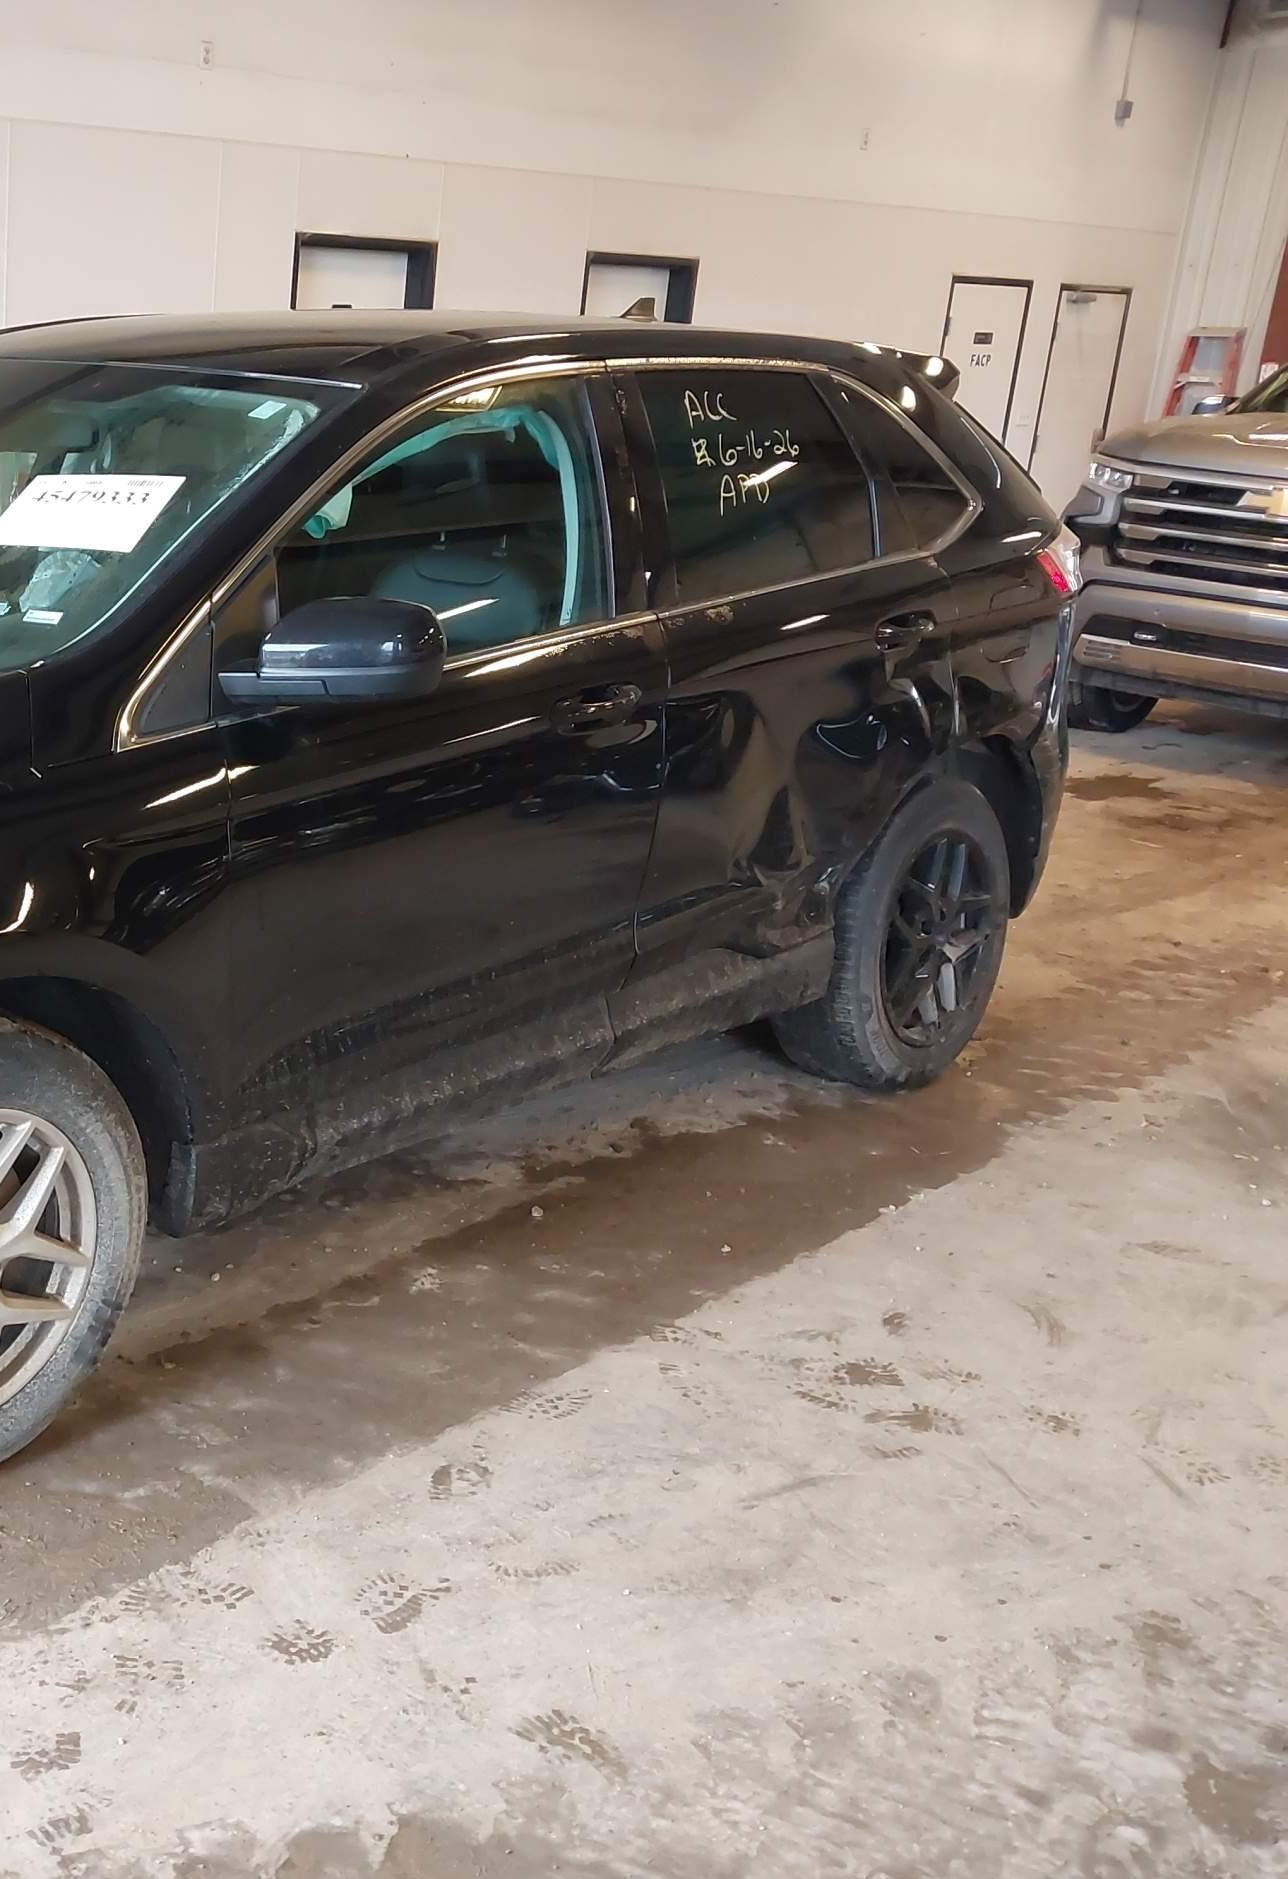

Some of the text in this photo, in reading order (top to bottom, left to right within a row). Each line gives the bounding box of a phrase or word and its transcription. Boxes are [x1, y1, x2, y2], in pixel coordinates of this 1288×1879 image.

[970, 354, 991, 367] FACP
[683, 389, 738, 429] ACC
[717, 428, 800, 467] 6-16-26
